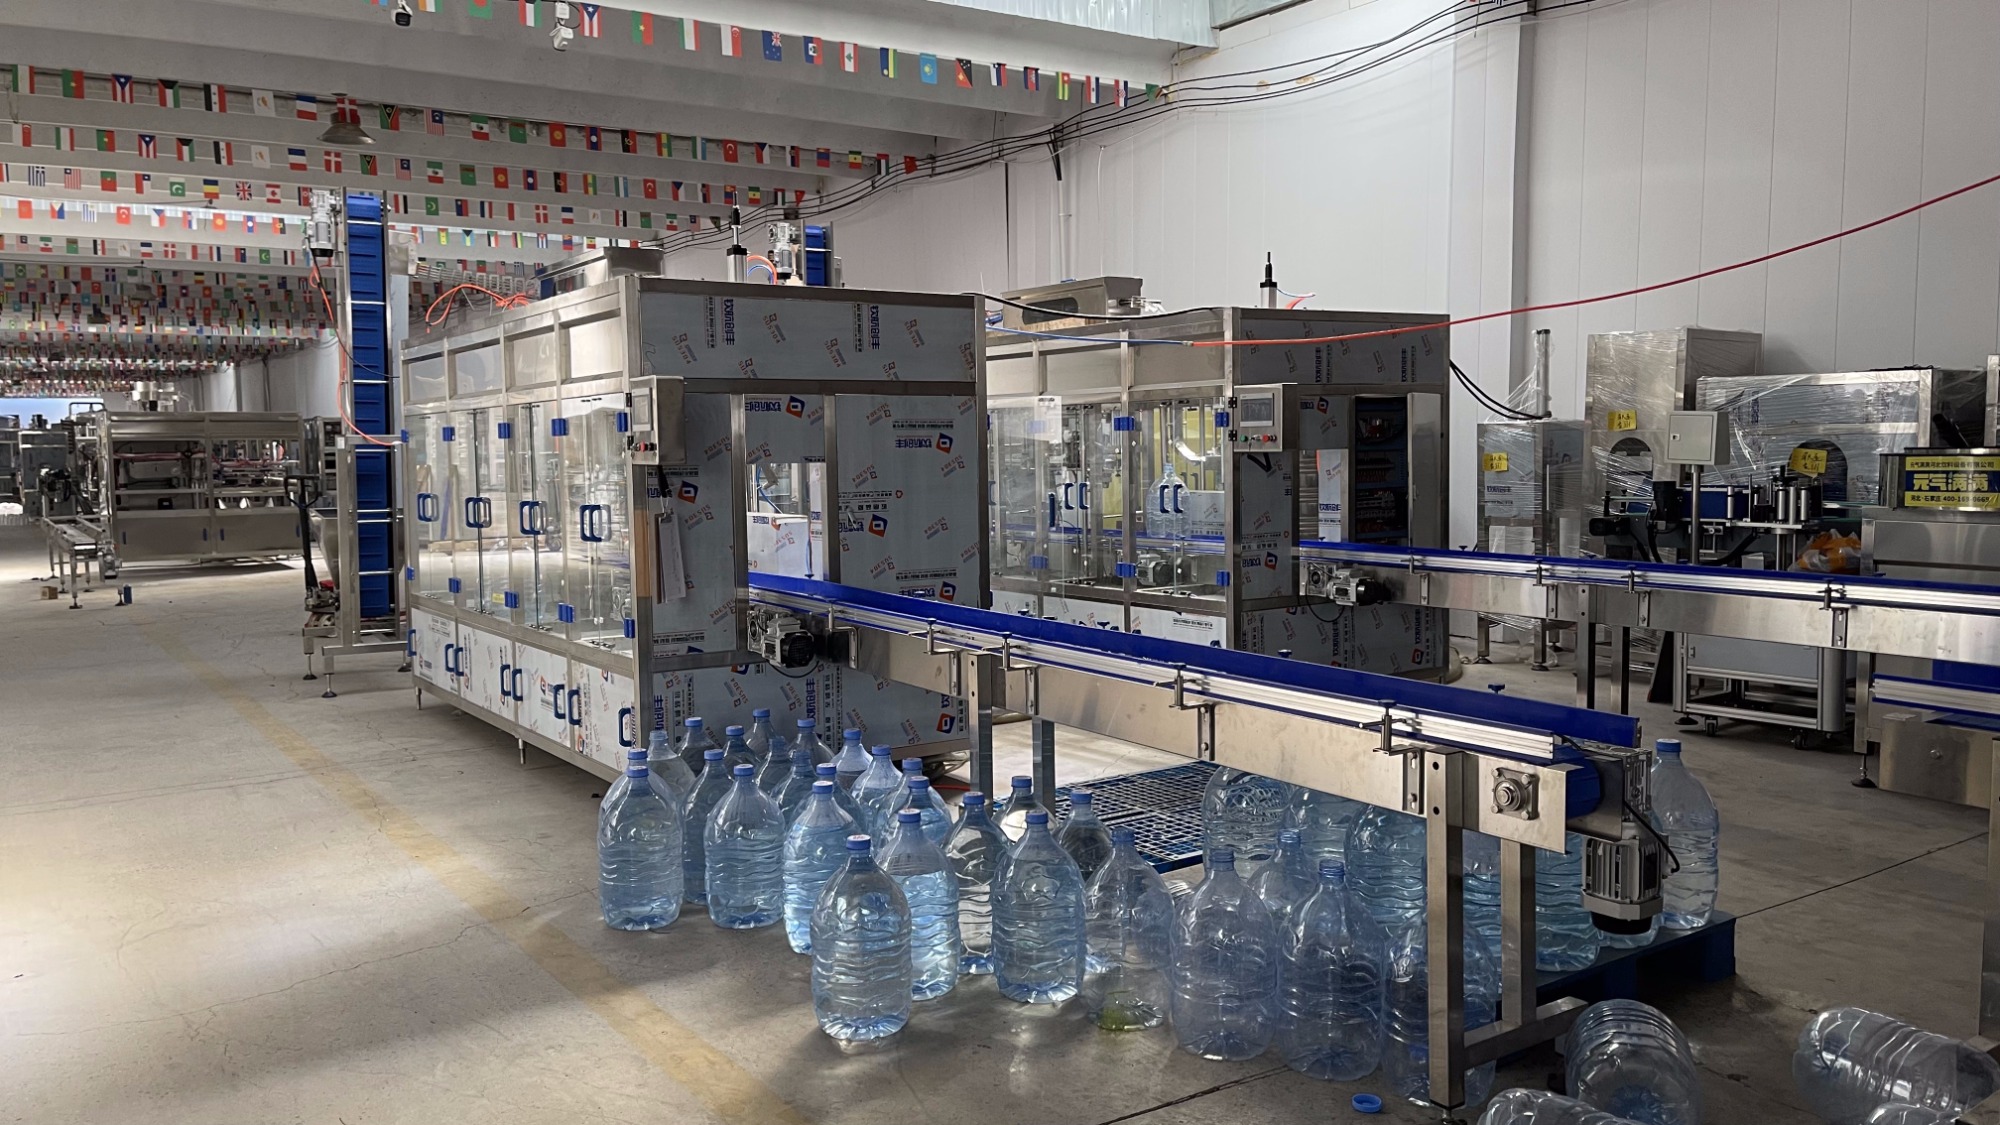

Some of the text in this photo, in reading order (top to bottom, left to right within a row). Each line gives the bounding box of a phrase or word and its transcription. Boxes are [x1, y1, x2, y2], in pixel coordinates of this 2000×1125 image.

[763, 316, 780, 344] SUS304
[904, 321, 920, 348] SUS304
[672, 336, 692, 364] SUS304
[824, 340, 841, 368] SUS304
[866, 403, 889, 420] SUS304
[704, 436, 731, 455] SUS304
[852, 464, 875, 482] SUS304
[940, 455, 963, 472] SUS304
[684, 504, 711, 524] SUS304
[924, 517, 946, 534] SUS304
[870, 555, 892, 574] SUS304
[730, 678, 748, 704] SUS304
[786, 682, 803, 707] SUS304
[906, 718, 921, 742] SUS304
